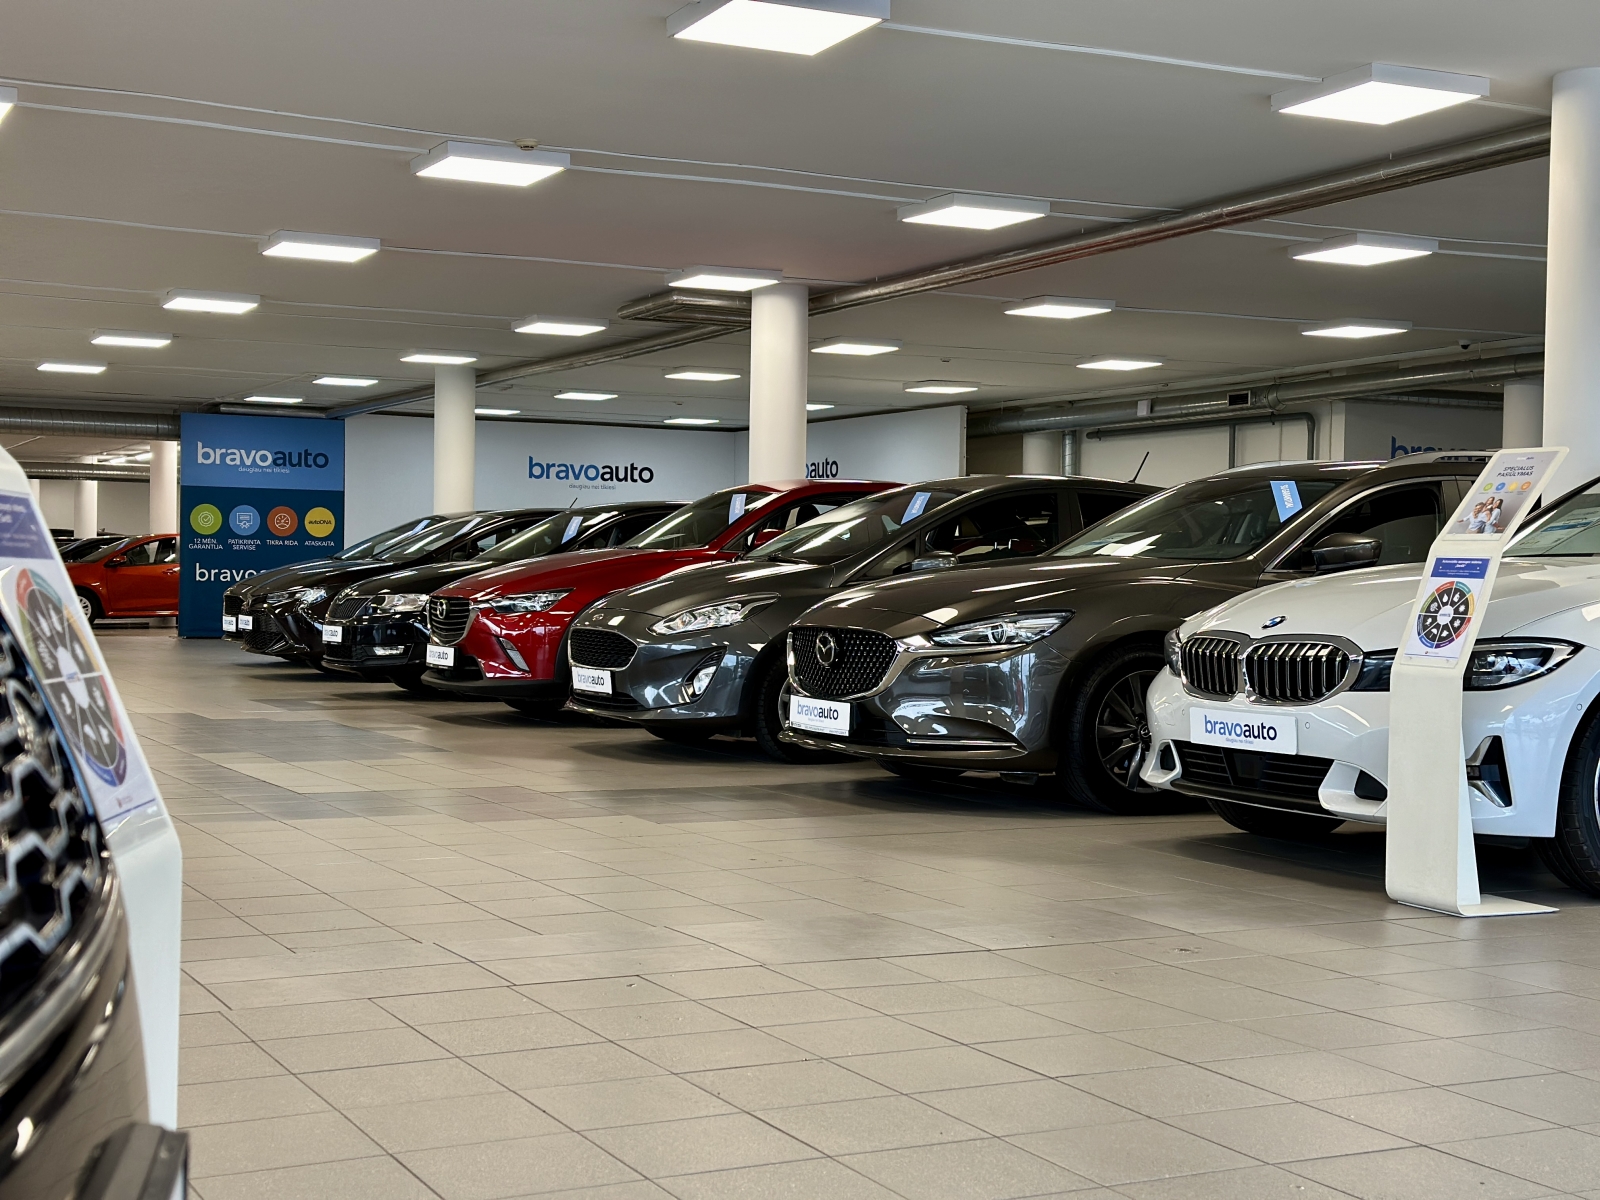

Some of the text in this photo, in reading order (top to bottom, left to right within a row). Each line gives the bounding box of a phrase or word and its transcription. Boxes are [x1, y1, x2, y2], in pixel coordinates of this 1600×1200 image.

[197, 441, 330, 469] bravoauto
[528, 455, 654, 483] bravoauto
[227, 538, 262, 546] PATIKRINTA
[796, 699, 839, 720] bravoauto
[1204, 715, 1277, 740] bravoauto
